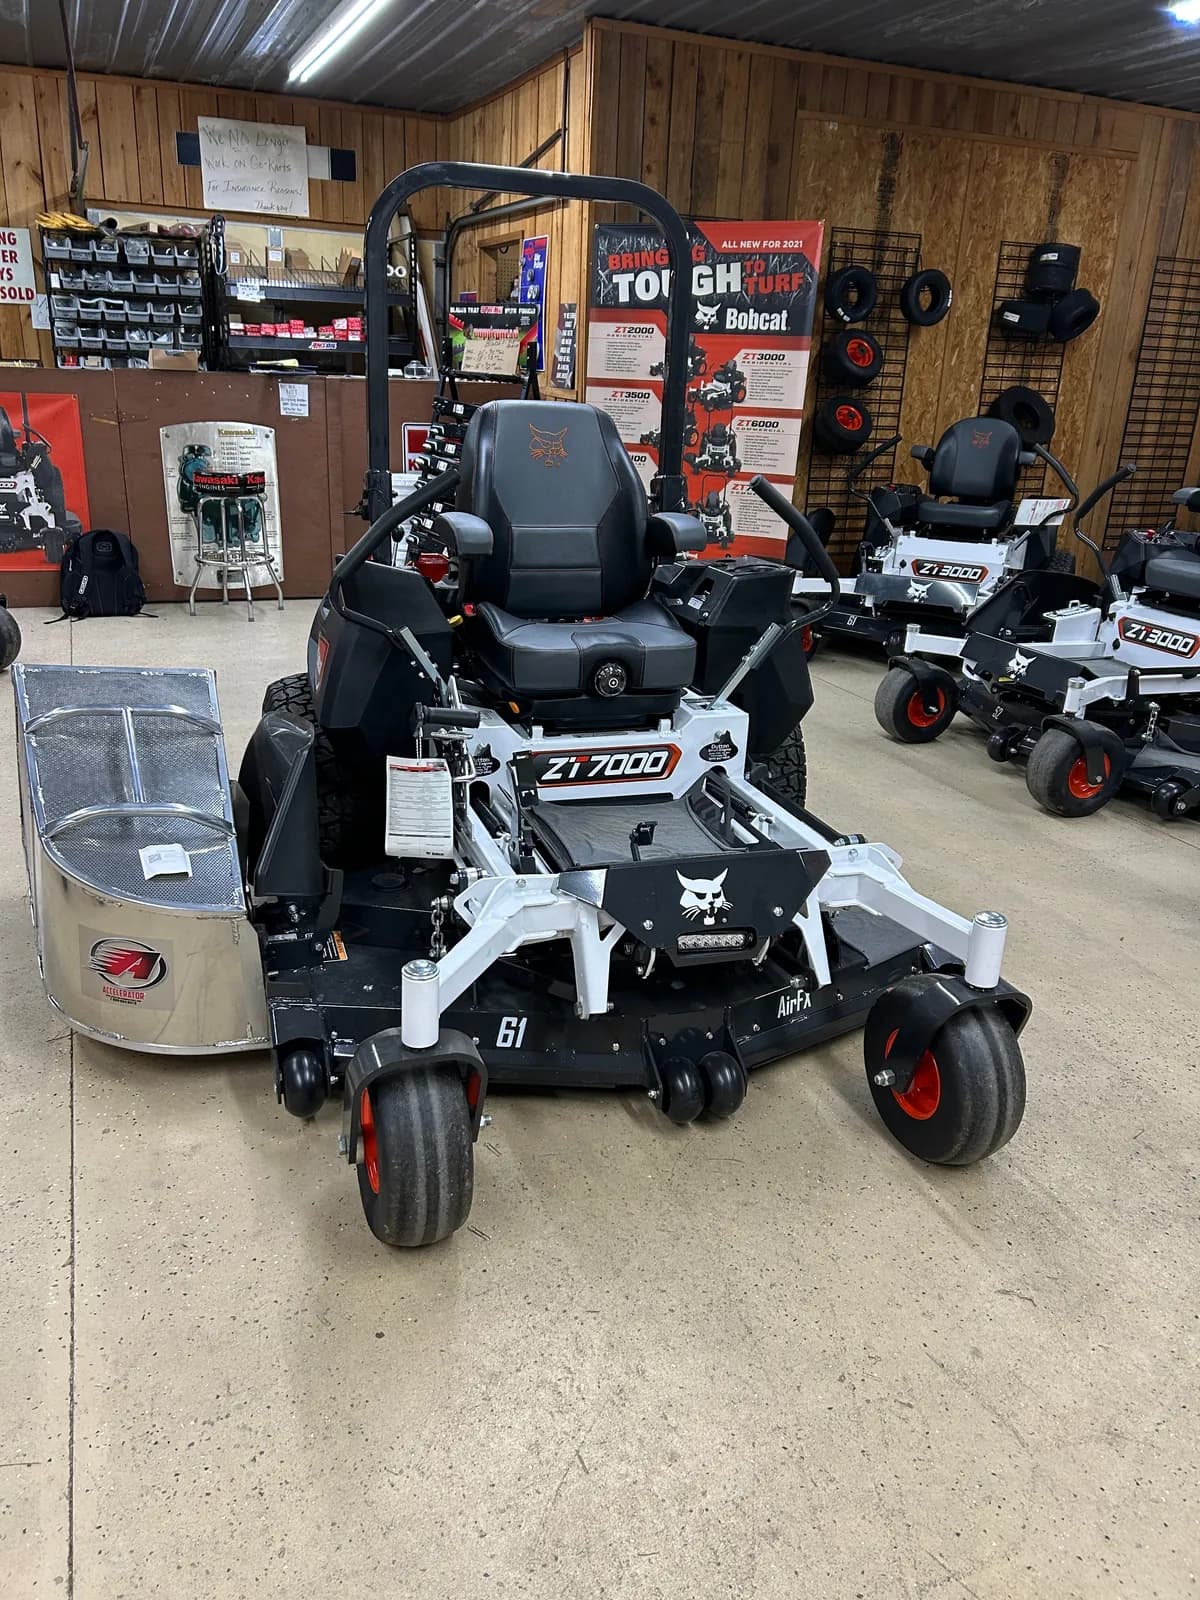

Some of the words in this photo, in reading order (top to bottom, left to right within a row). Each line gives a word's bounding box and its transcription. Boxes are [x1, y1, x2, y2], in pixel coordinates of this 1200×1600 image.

[722, 240, 737, 248] ALL
[740, 240, 760, 249] NEW
[763, 240, 781, 248] FOR
[782, 239, 803, 248] 2021
[608, 245, 705, 271] BRINGG
[744, 259, 766, 273] TO
[744, 272, 804, 296] TURF
[726, 308, 788, 330] Bobcat
[614, 326, 654, 334] ZT2000
[611, 391, 650, 399] ZT3500
[737, 420, 779, 428] ZT6000
[919, 563, 982, 580] ZT3000
[1125, 623, 1195, 654] ZT3000
[541, 750, 669, 780] ZT7000
[103, 985, 145, 1000] ACCELERATOR
[496, 1016, 528, 1048] 61
